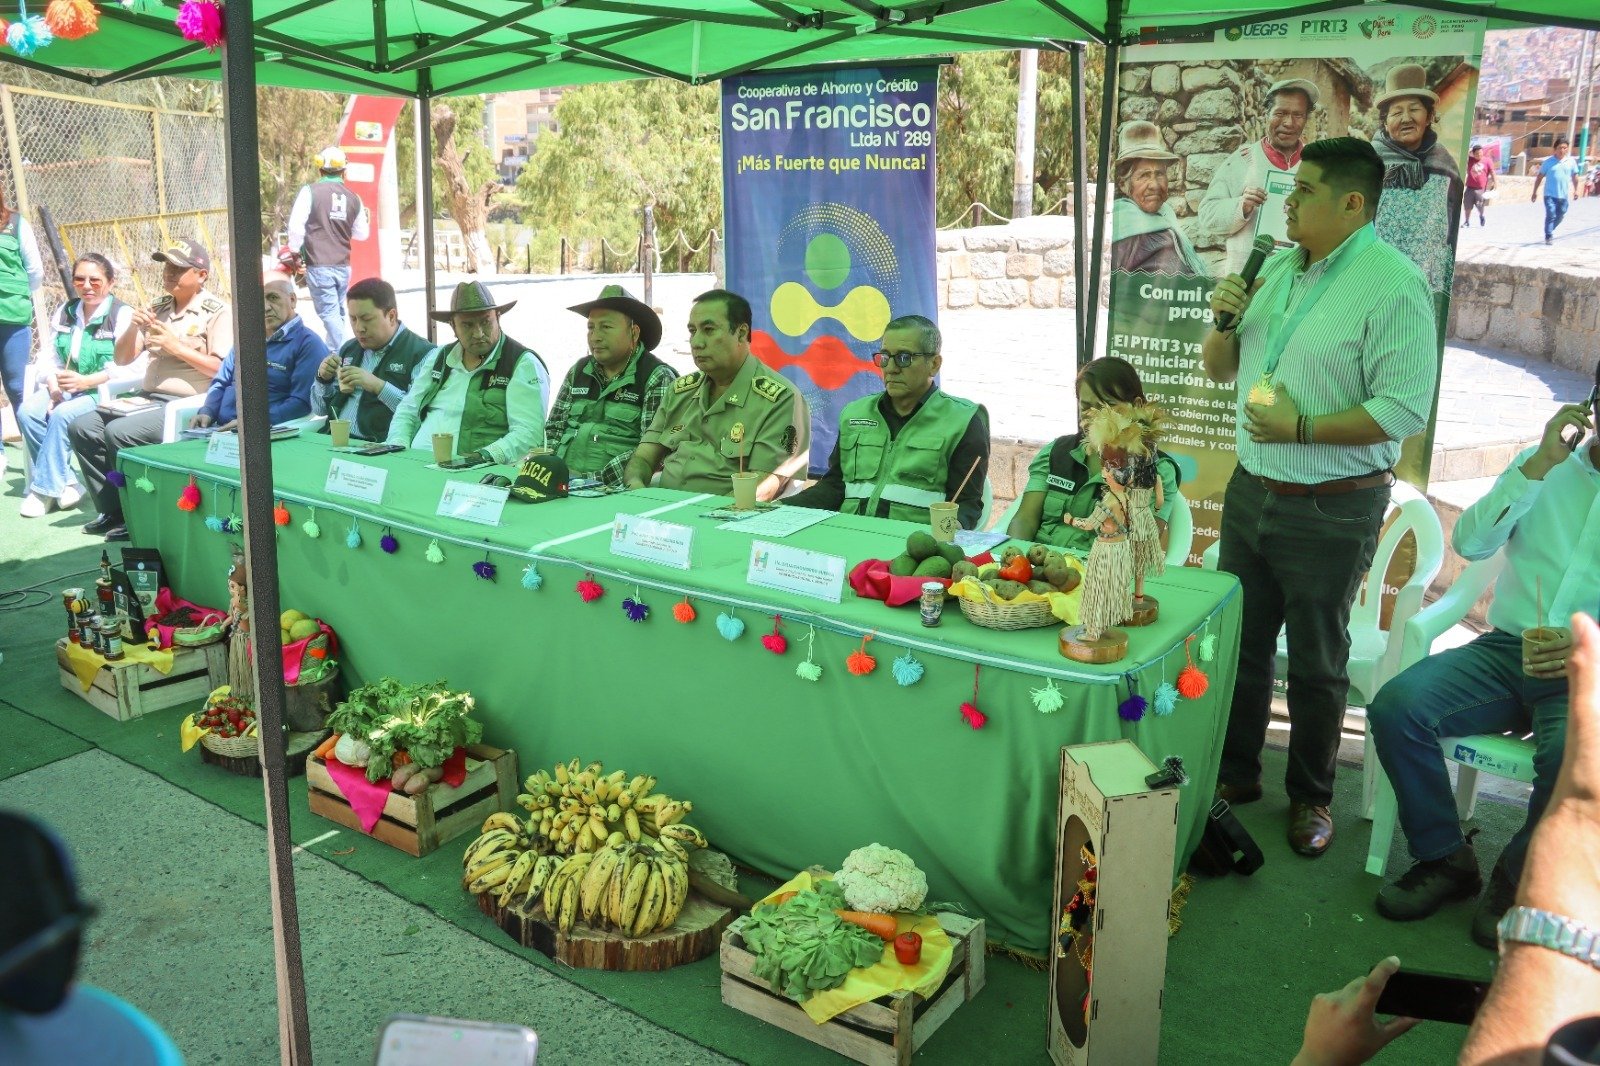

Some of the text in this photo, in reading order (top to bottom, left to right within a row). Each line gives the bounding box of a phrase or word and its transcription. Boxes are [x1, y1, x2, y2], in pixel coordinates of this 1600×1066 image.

[1243, 23, 1289, 36] UEGPS
[1300, 19, 1348, 33] PTRT3
[737, 79, 918, 100] Cooperativa de Ahorro y Crédito
[731, 97, 931, 131] San Francisco
[850, 131, 882, 147] Ltda
[904, 130, 931, 147] 289
[737, 154, 927, 175] ¡Más Fuerte que Nunca!
[1139, 284, 1174, 300] Con
[1177, 286, 1202, 302] mi
[1131, 335, 1180, 352] PTRT3
[1183, 342, 1203, 355] ya
[1146, 353, 1196, 370] iniciar
[1206, 378, 1216, 389] a
[1178, 394, 1209, 408] través
[1211, 399, 1226, 410] de
[1227, 400, 1237, 411] la
[1171, 407, 1220, 422] Gobierno
[1205, 424, 1214, 436] la
[1217, 427, 1236, 438] titu
[1209, 441, 1217, 451] y
